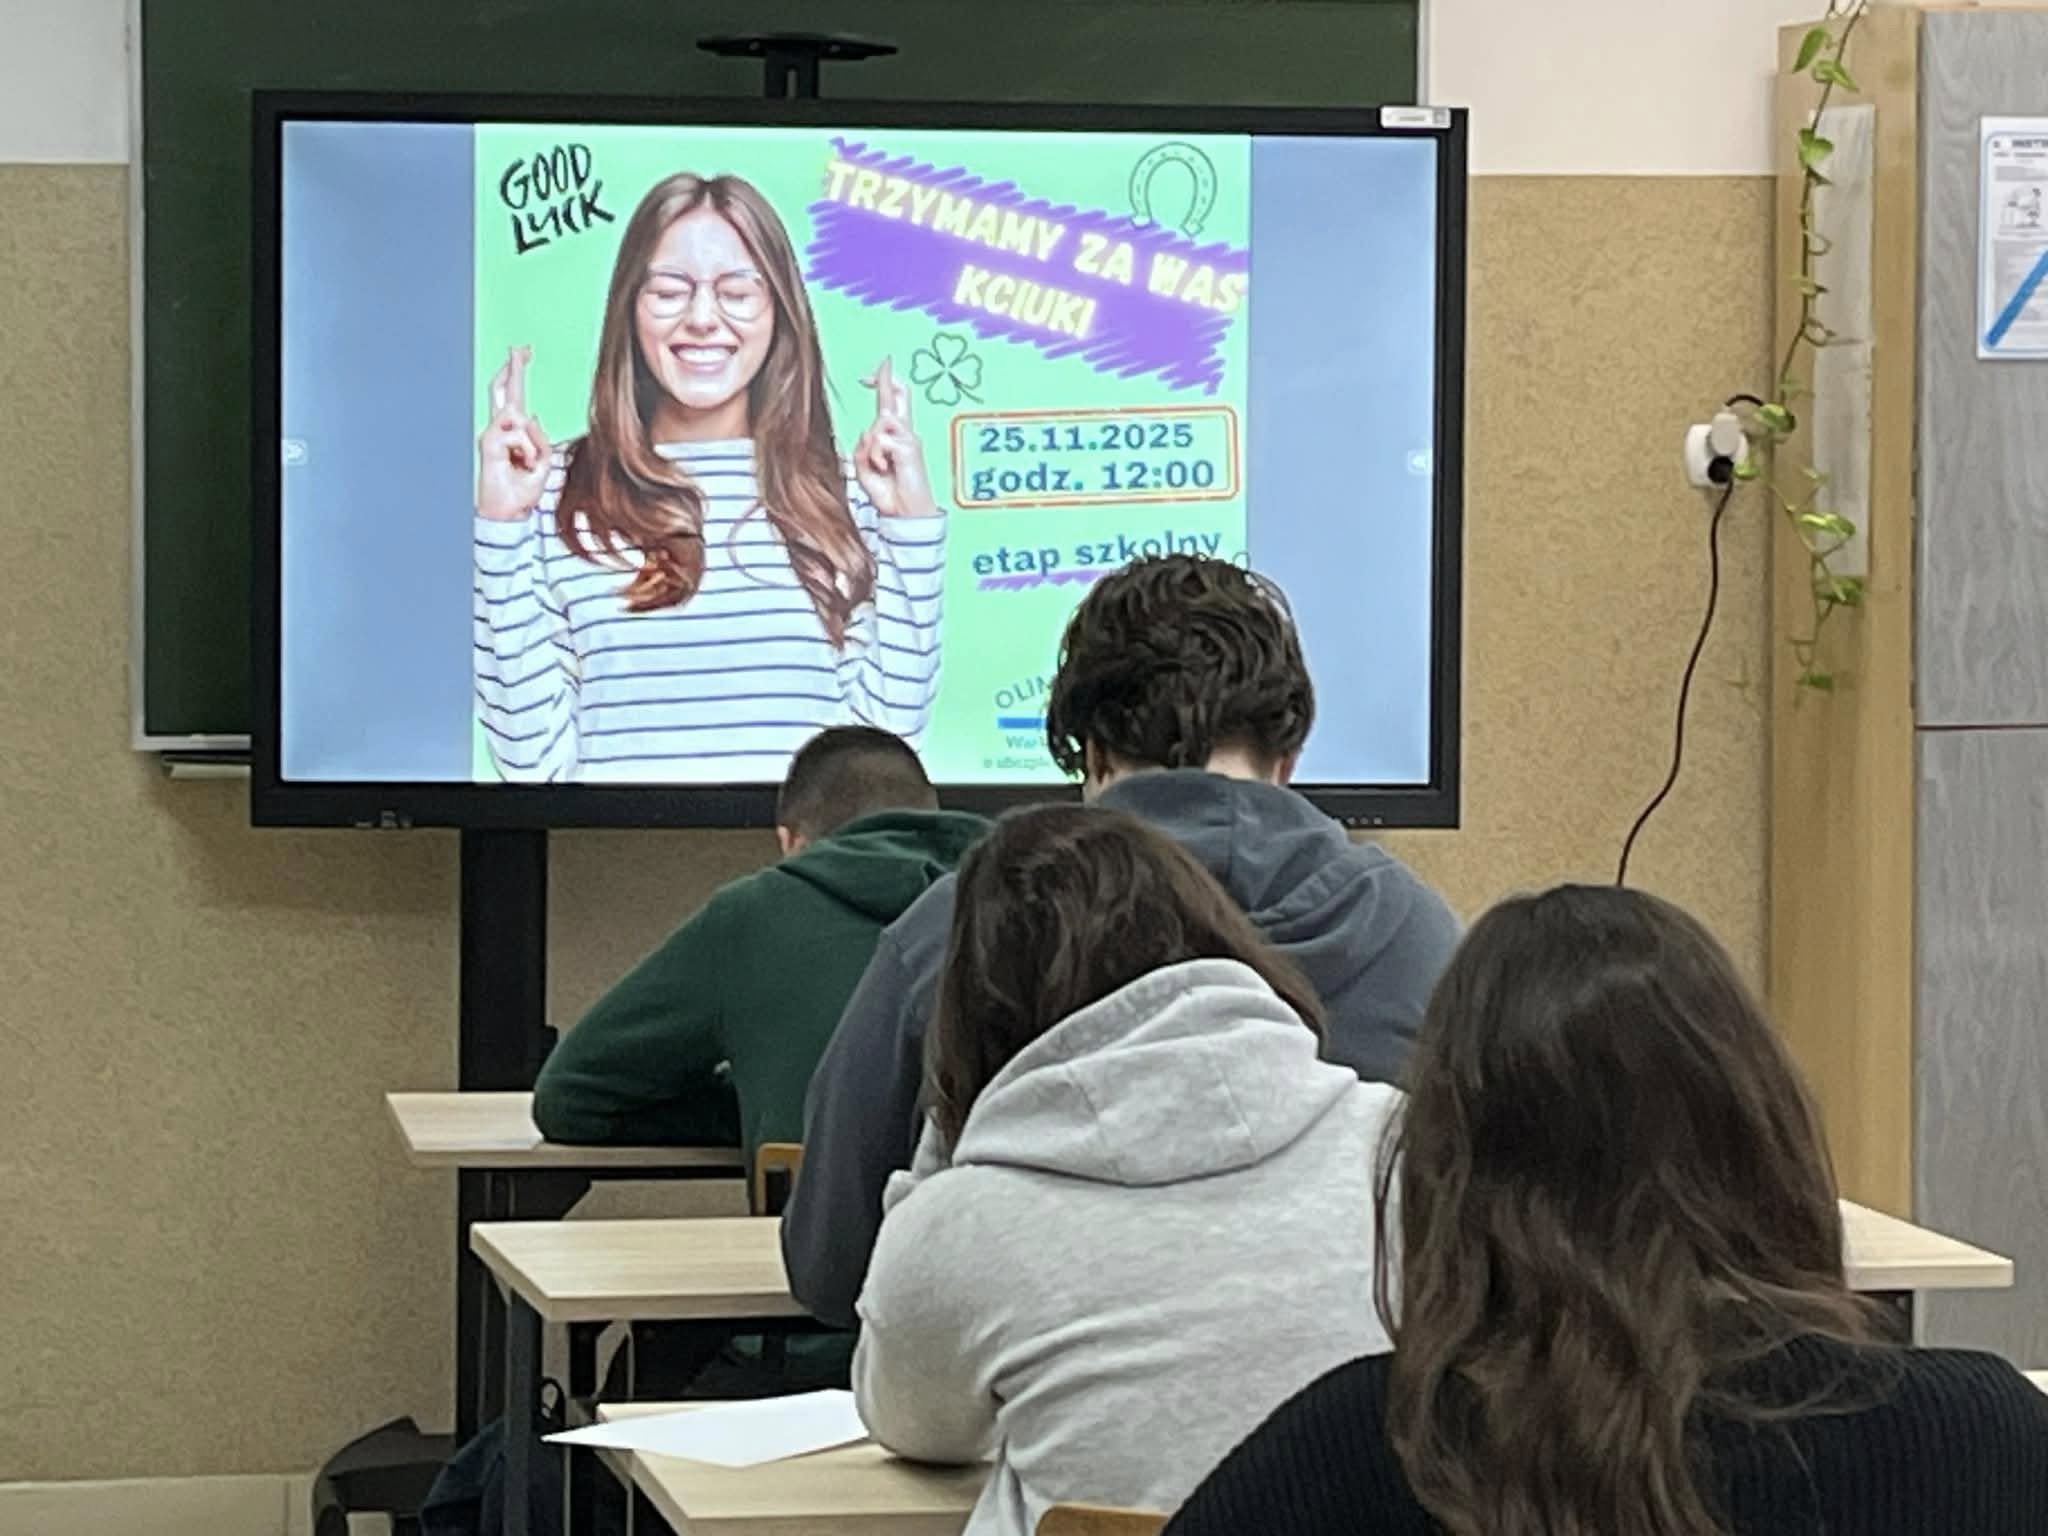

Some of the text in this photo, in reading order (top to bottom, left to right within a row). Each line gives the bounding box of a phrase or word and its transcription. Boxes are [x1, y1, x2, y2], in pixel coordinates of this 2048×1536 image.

[500, 143, 592, 210] GOOD
[511, 180, 615, 254] LUCK
[827, 159, 1248, 314] TRZYMAMY ZA WAS
[954, 265, 1097, 338] KCIUKI
[979, 423, 1194, 452] 25.11.2025
[972, 459, 1215, 500] godz. 12:00
[972, 545, 1061, 576] etap
